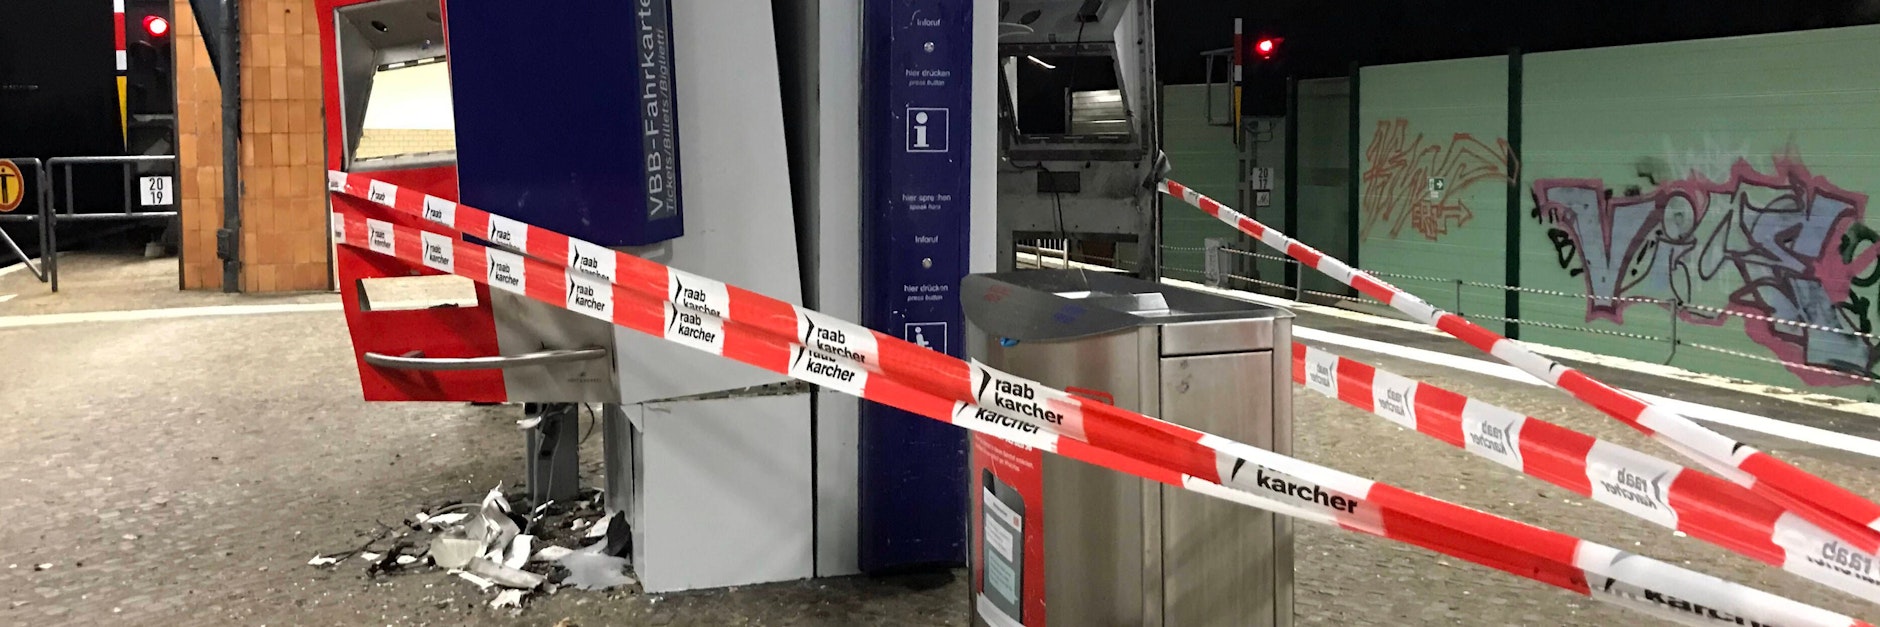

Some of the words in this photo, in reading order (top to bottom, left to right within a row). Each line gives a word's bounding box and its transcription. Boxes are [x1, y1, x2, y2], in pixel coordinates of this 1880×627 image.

[905, 68, 920, 77] hier
[1258, 168, 1269, 178] 20
[149, 178, 164, 191] 20
[1259, 179, 1268, 190] 17
[150, 191, 163, 205] 19
[902, 193, 918, 202] hier
[430, 208, 443, 219] raab
[497, 228, 511, 242] raab
[914, 235, 939, 244] Inforuf
[430, 243, 442, 255] raab
[429, 253, 450, 266] karcher
[581, 256, 599, 270] raab
[496, 261, 511, 274] raab
[495, 271, 520, 286] karcher
[577, 284, 594, 298] raab
[684, 287, 706, 302] raab
[903, 284, 919, 293] hier
[575, 293, 606, 312] karcher
[679, 312, 702, 327] raab
[678, 322, 716, 343] karcher
[818, 327, 845, 345] raab
[816, 339, 866, 364] karcher
[806, 358, 856, 383] karcher
[995, 378, 1034, 400] raab
[994, 391, 1064, 426] karcher
[1257, 468, 1358, 514] karcher
